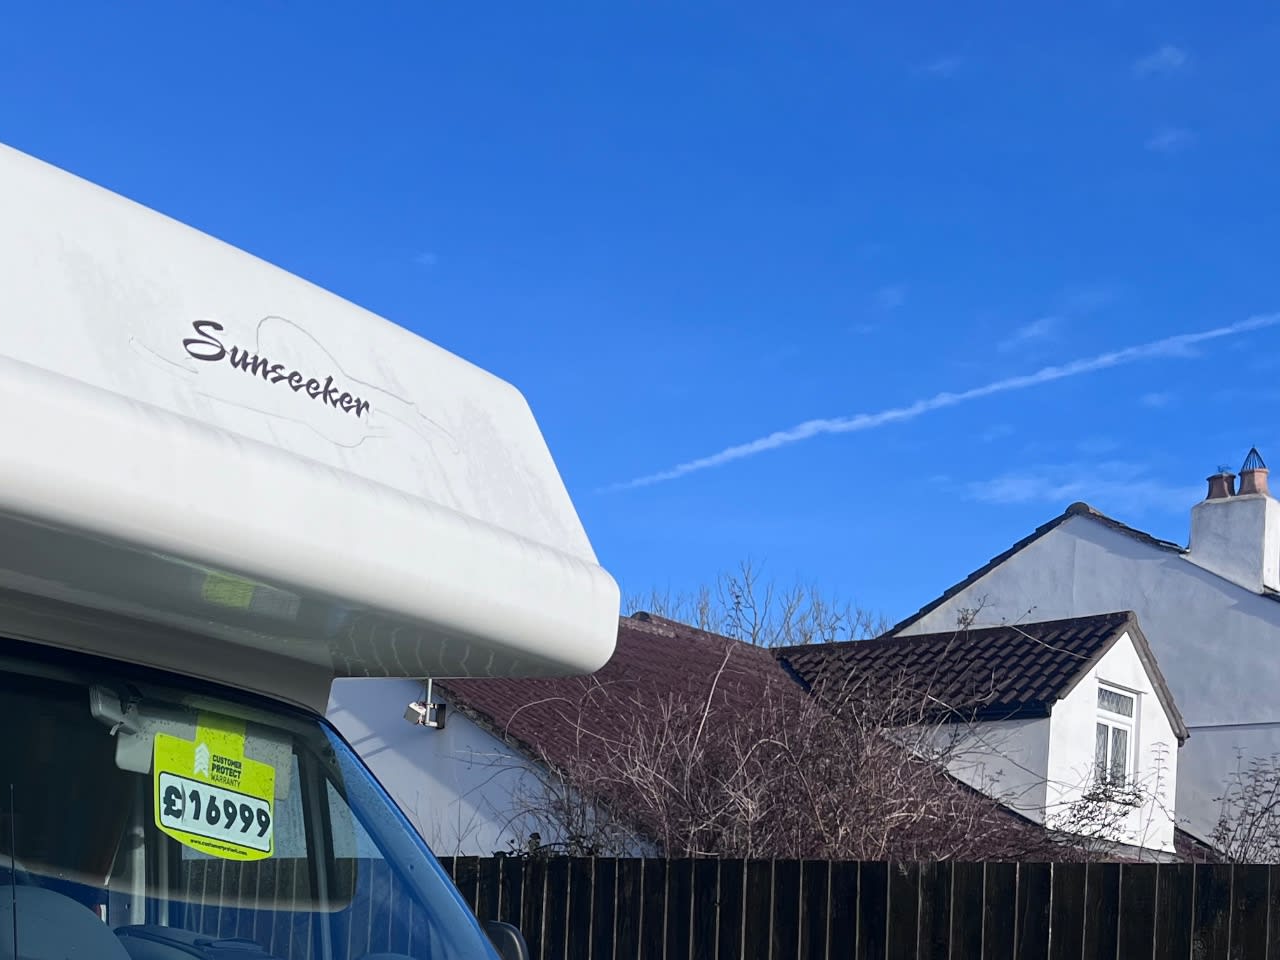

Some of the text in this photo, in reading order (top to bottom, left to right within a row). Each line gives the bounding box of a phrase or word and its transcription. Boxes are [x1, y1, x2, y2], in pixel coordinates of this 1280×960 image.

[182, 319, 370, 418] Sunseeker
[212, 754, 242, 770] CUSTOMER
[211, 763, 241, 779] PROTECT
[211, 773, 241, 789] WARRANTY
[163, 785, 271, 838] £16999
